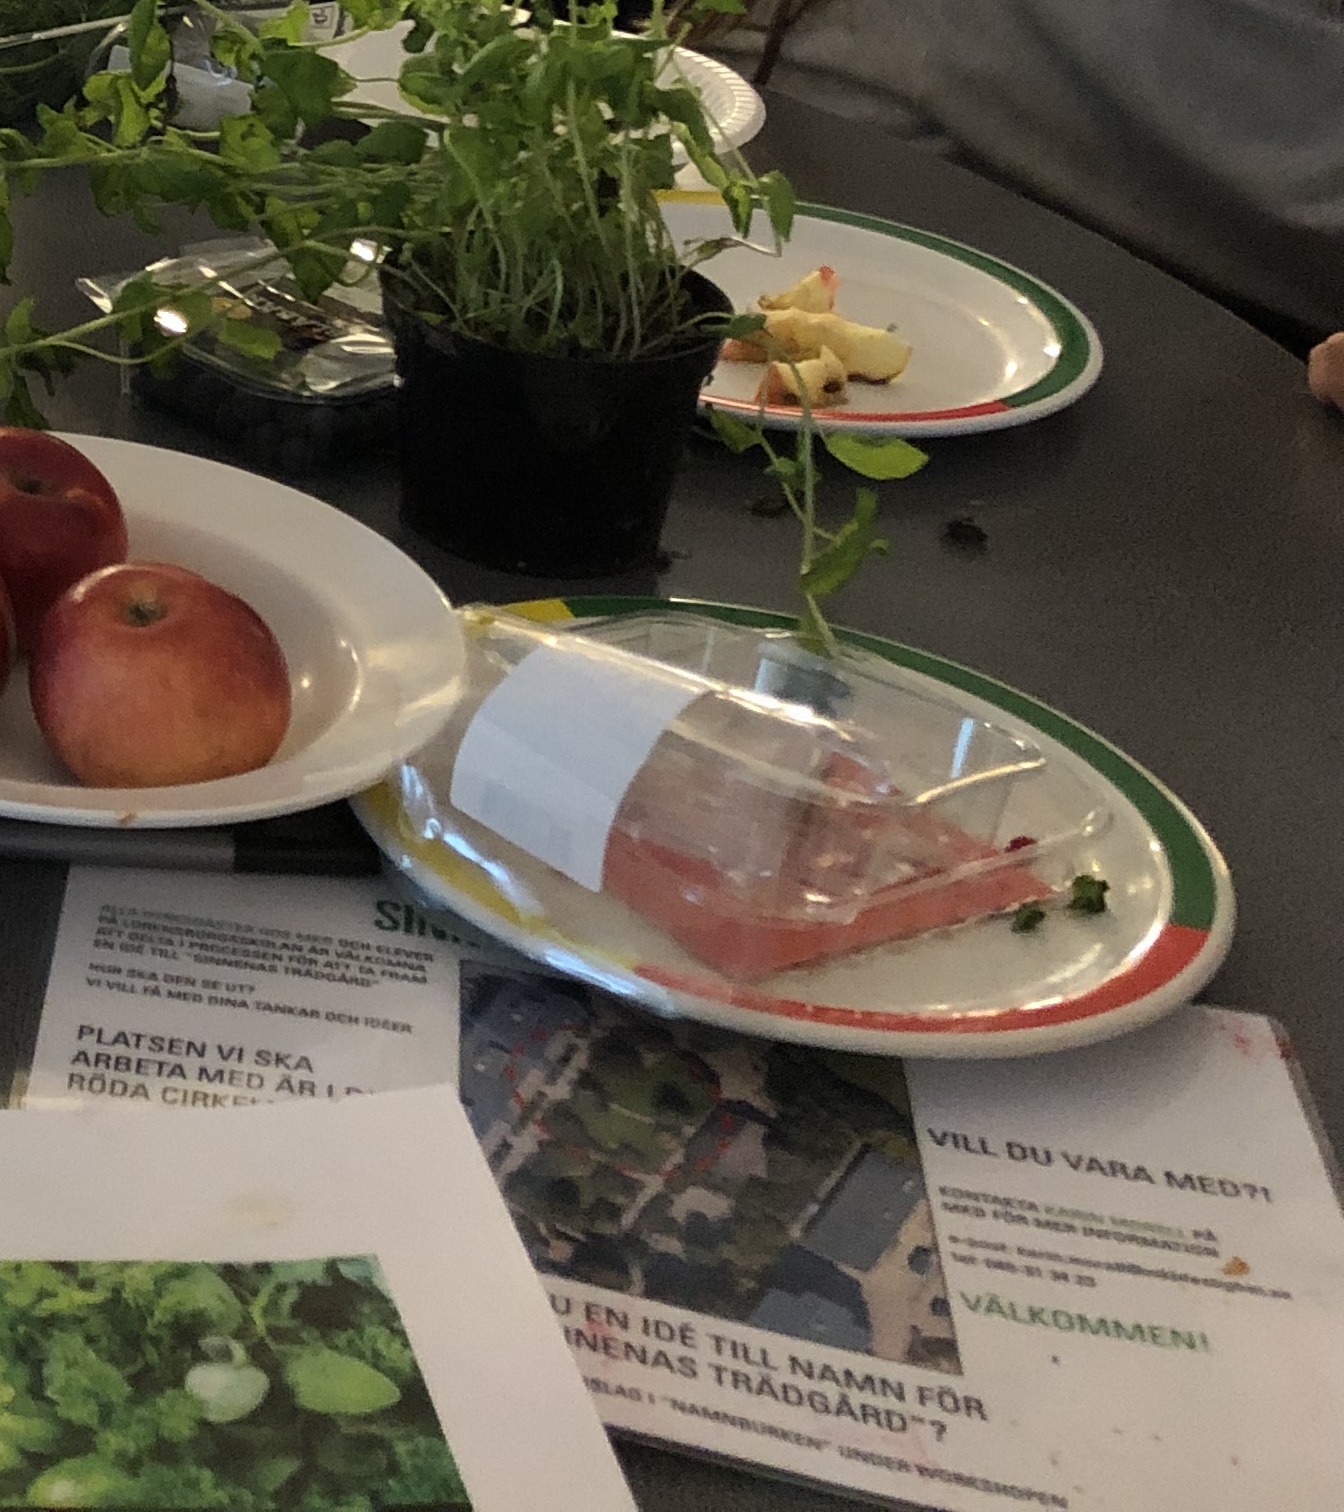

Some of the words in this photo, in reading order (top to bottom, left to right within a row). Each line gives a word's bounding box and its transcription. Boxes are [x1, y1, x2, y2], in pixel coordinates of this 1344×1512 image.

[166, 989, 203, 1003] MED
[324, 1011, 360, 1026] OCH
[71, 1050, 186, 1081] ARBETA
[197, 1066, 265, 1090] MED
[274, 1074, 316, 1098] ÄR
[77, 1024, 207, 1059] PLATSEN
[217, 1044, 245, 1065] VI
[253, 1049, 315, 1074] SKA
[67, 1072, 151, 1102] RÖDA
[926, 1127, 999, 1157] VILL
[1005, 1141, 1053, 1168] DU
[1061, 1151, 1156, 1185] VARA
[959, 1290, 1210, 1351] VÄLKOMMEN!
[583, 1302, 630, 1331] EN
[641, 1316, 698, 1349] IDÉ
[706, 1333, 779, 1371] TILL
[787, 1354, 906, 1403] NAMN
[917, 1384, 990, 1422] FÖR
